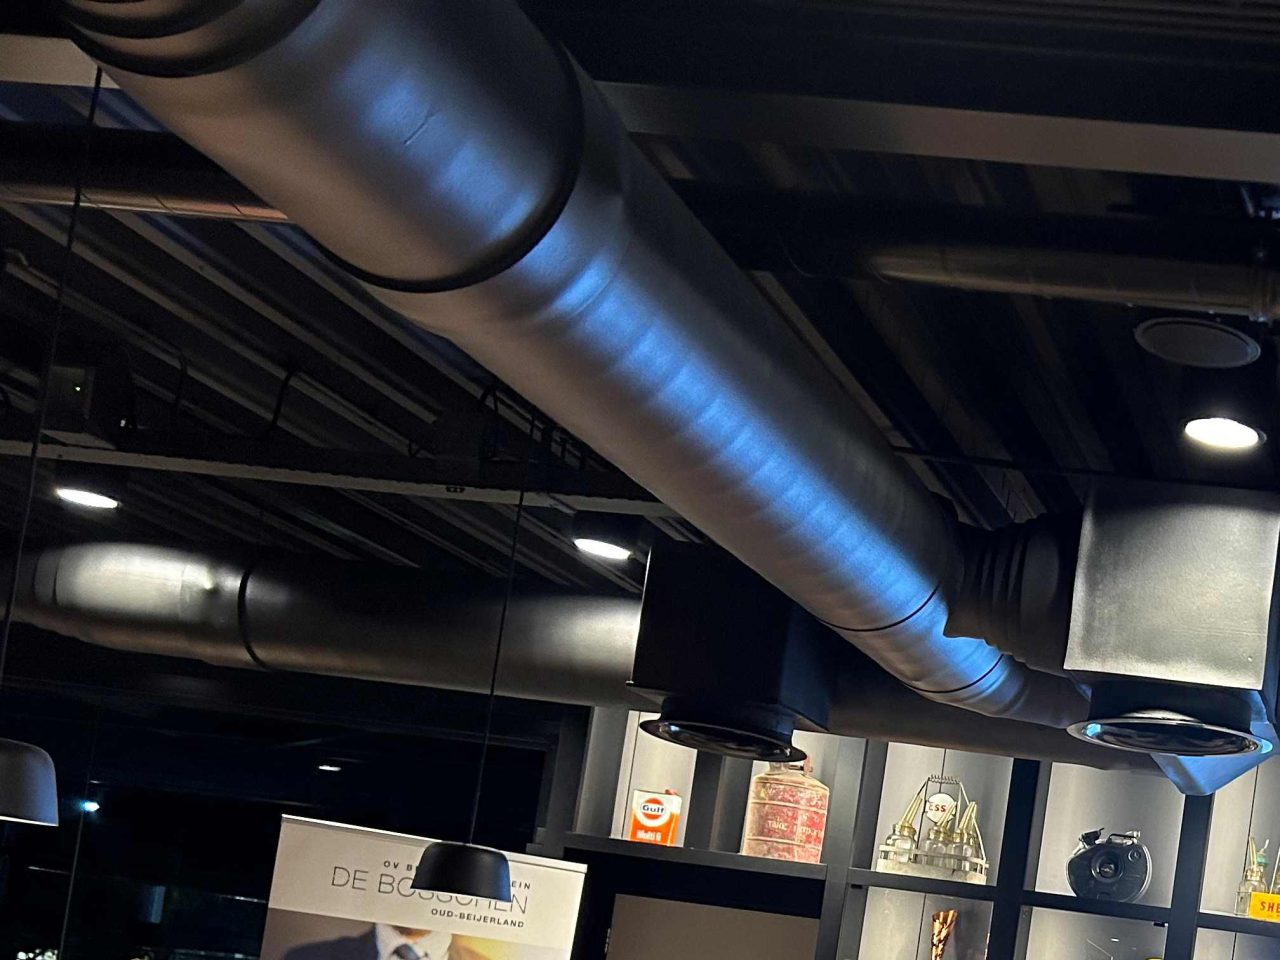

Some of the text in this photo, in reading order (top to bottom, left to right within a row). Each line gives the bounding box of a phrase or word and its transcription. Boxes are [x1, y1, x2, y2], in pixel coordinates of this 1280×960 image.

[642, 804, 664, 813] Gulf
[929, 801, 947, 812] ESS
[383, 860, 399, 869] OV
[331, 866, 369, 891] DE
[431, 908, 524, 928] OUD-BEIJERLAND
